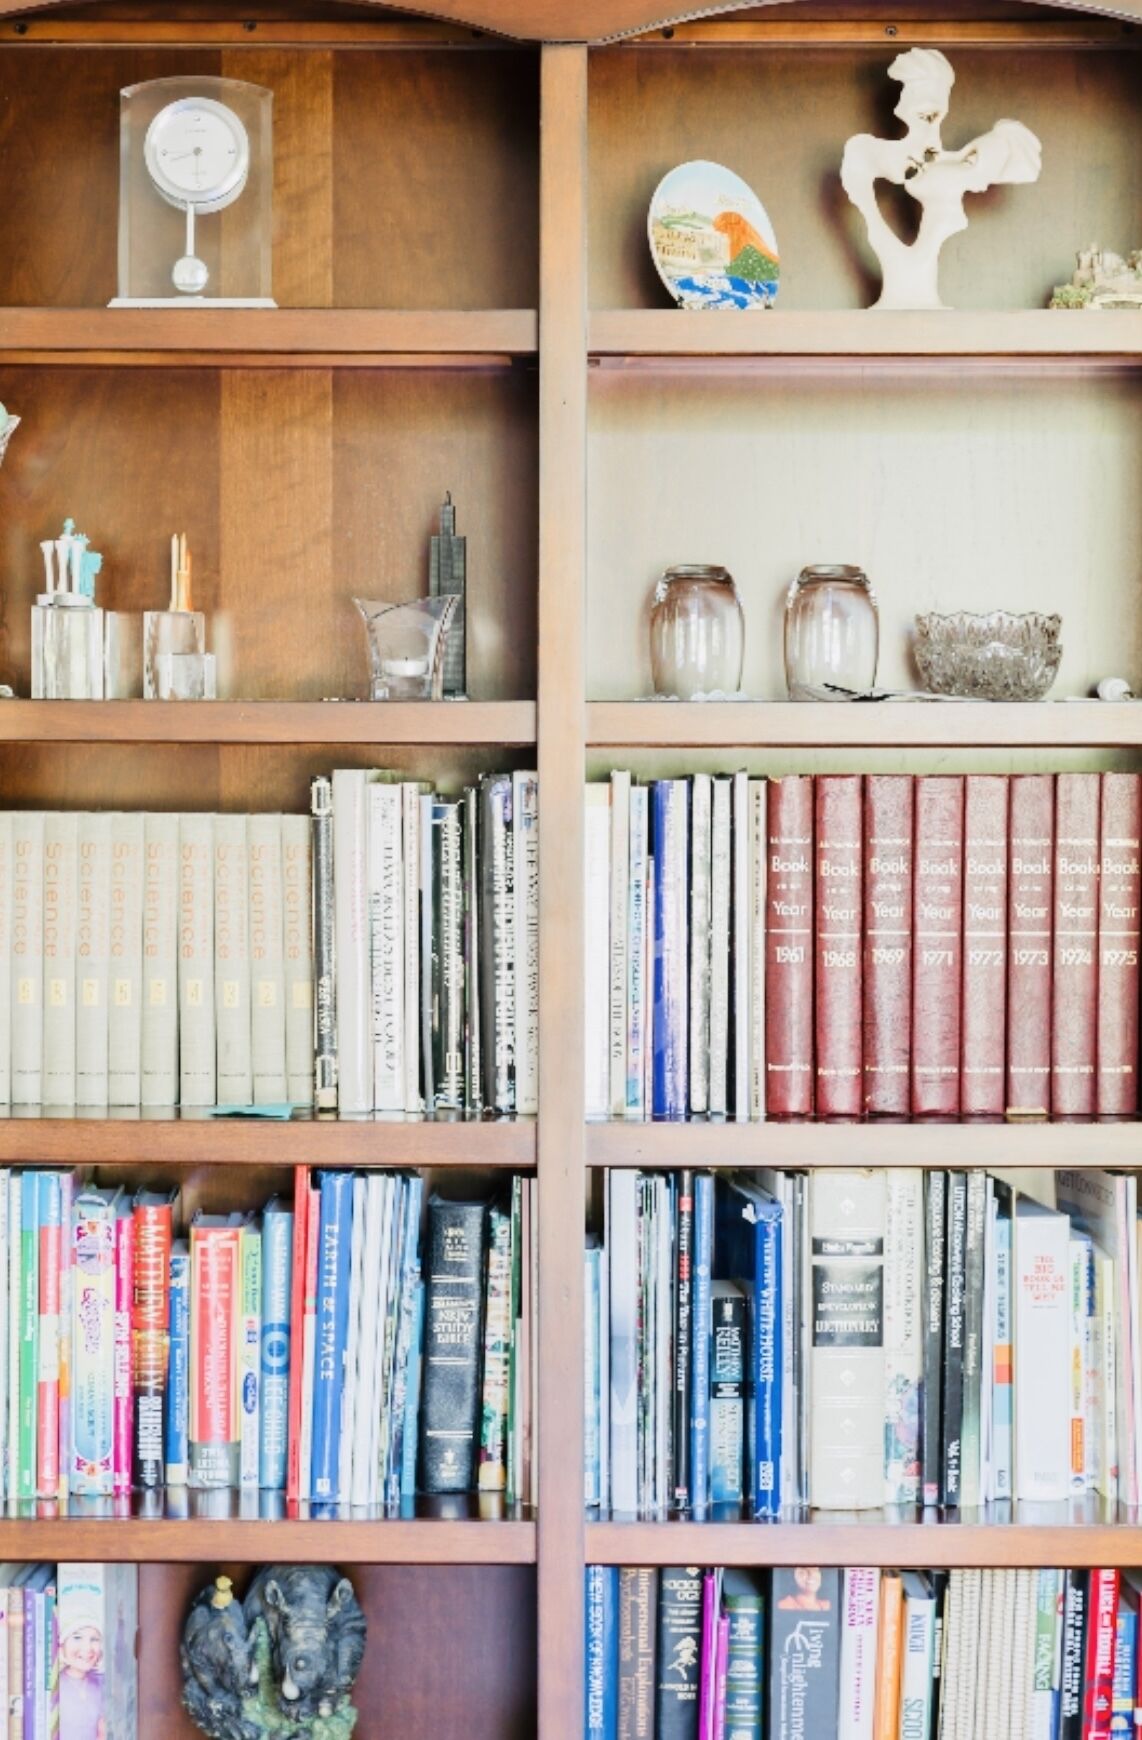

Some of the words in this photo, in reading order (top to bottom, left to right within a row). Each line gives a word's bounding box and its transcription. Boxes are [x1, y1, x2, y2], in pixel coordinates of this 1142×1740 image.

[771, 855, 808, 872] Book
[820, 860, 858, 877] Book
[870, 858, 908, 875] Book
[919, 858, 957, 876] Book
[966, 858, 1005, 874] Book
[1012, 858, 1050, 874] Book
[1059, 858, 1096, 874] Book
[1102, 858, 1139, 874] Book
[773, 902, 806, 916] Year
[823, 906, 857, 920] Year
[871, 902, 904, 917] Year
[920, 904, 955, 920] Year
[969, 904, 1002, 920] Year
[1014, 903, 1048, 918] Year
[1060, 903, 1093, 918] Year
[1104, 904, 1137, 918] Year
[823, 951, 856, 967] 1968
[872, 948, 904, 964] 1969
[922, 951, 952, 966] 1971
[969, 950, 1003, 966] 1972
[1014, 949, 1048, 966] 1973
[1061, 949, 1092, 965] 1974
[1102, 949, 1137, 966] 1975
[930, 1180, 943, 1237] microwave
[952, 1221, 964, 1272] Microwave
[323, 1223, 339, 1288] EARTH
[138, 1224, 165, 1324] MATTHEW
[1034, 1264, 1054, 1274] BIG
[949, 1275, 963, 1315] Cooking
[322, 1297, 333, 1312] &
[760, 1288, 776, 1332] WHITE
[930, 1289, 942, 1333] desserts
[433, 1322, 475, 1333] STUDY
[950, 1316, 962, 1348] School
[437, 1333, 470, 1344] BIBLE
[321, 1321, 335, 1381] SPACE
[716, 1327, 731, 1377] REILLY
[730, 1327, 741, 1378] MATTHEW
[760, 1334, 774, 1382] HOUSE
[265, 1378, 282, 1404] LEE
[265, 1409, 282, 1453] CHILD
[1100, 1583, 1115, 1613] LUCK
[637, 1567, 653, 1653] Interpersonal
[797, 1620, 830, 1668] Living
[1097, 1627, 1113, 1675] TROUBLE
[1036, 1633, 1051, 1690] FACING
[635, 1658, 653, 1737] Explorations
